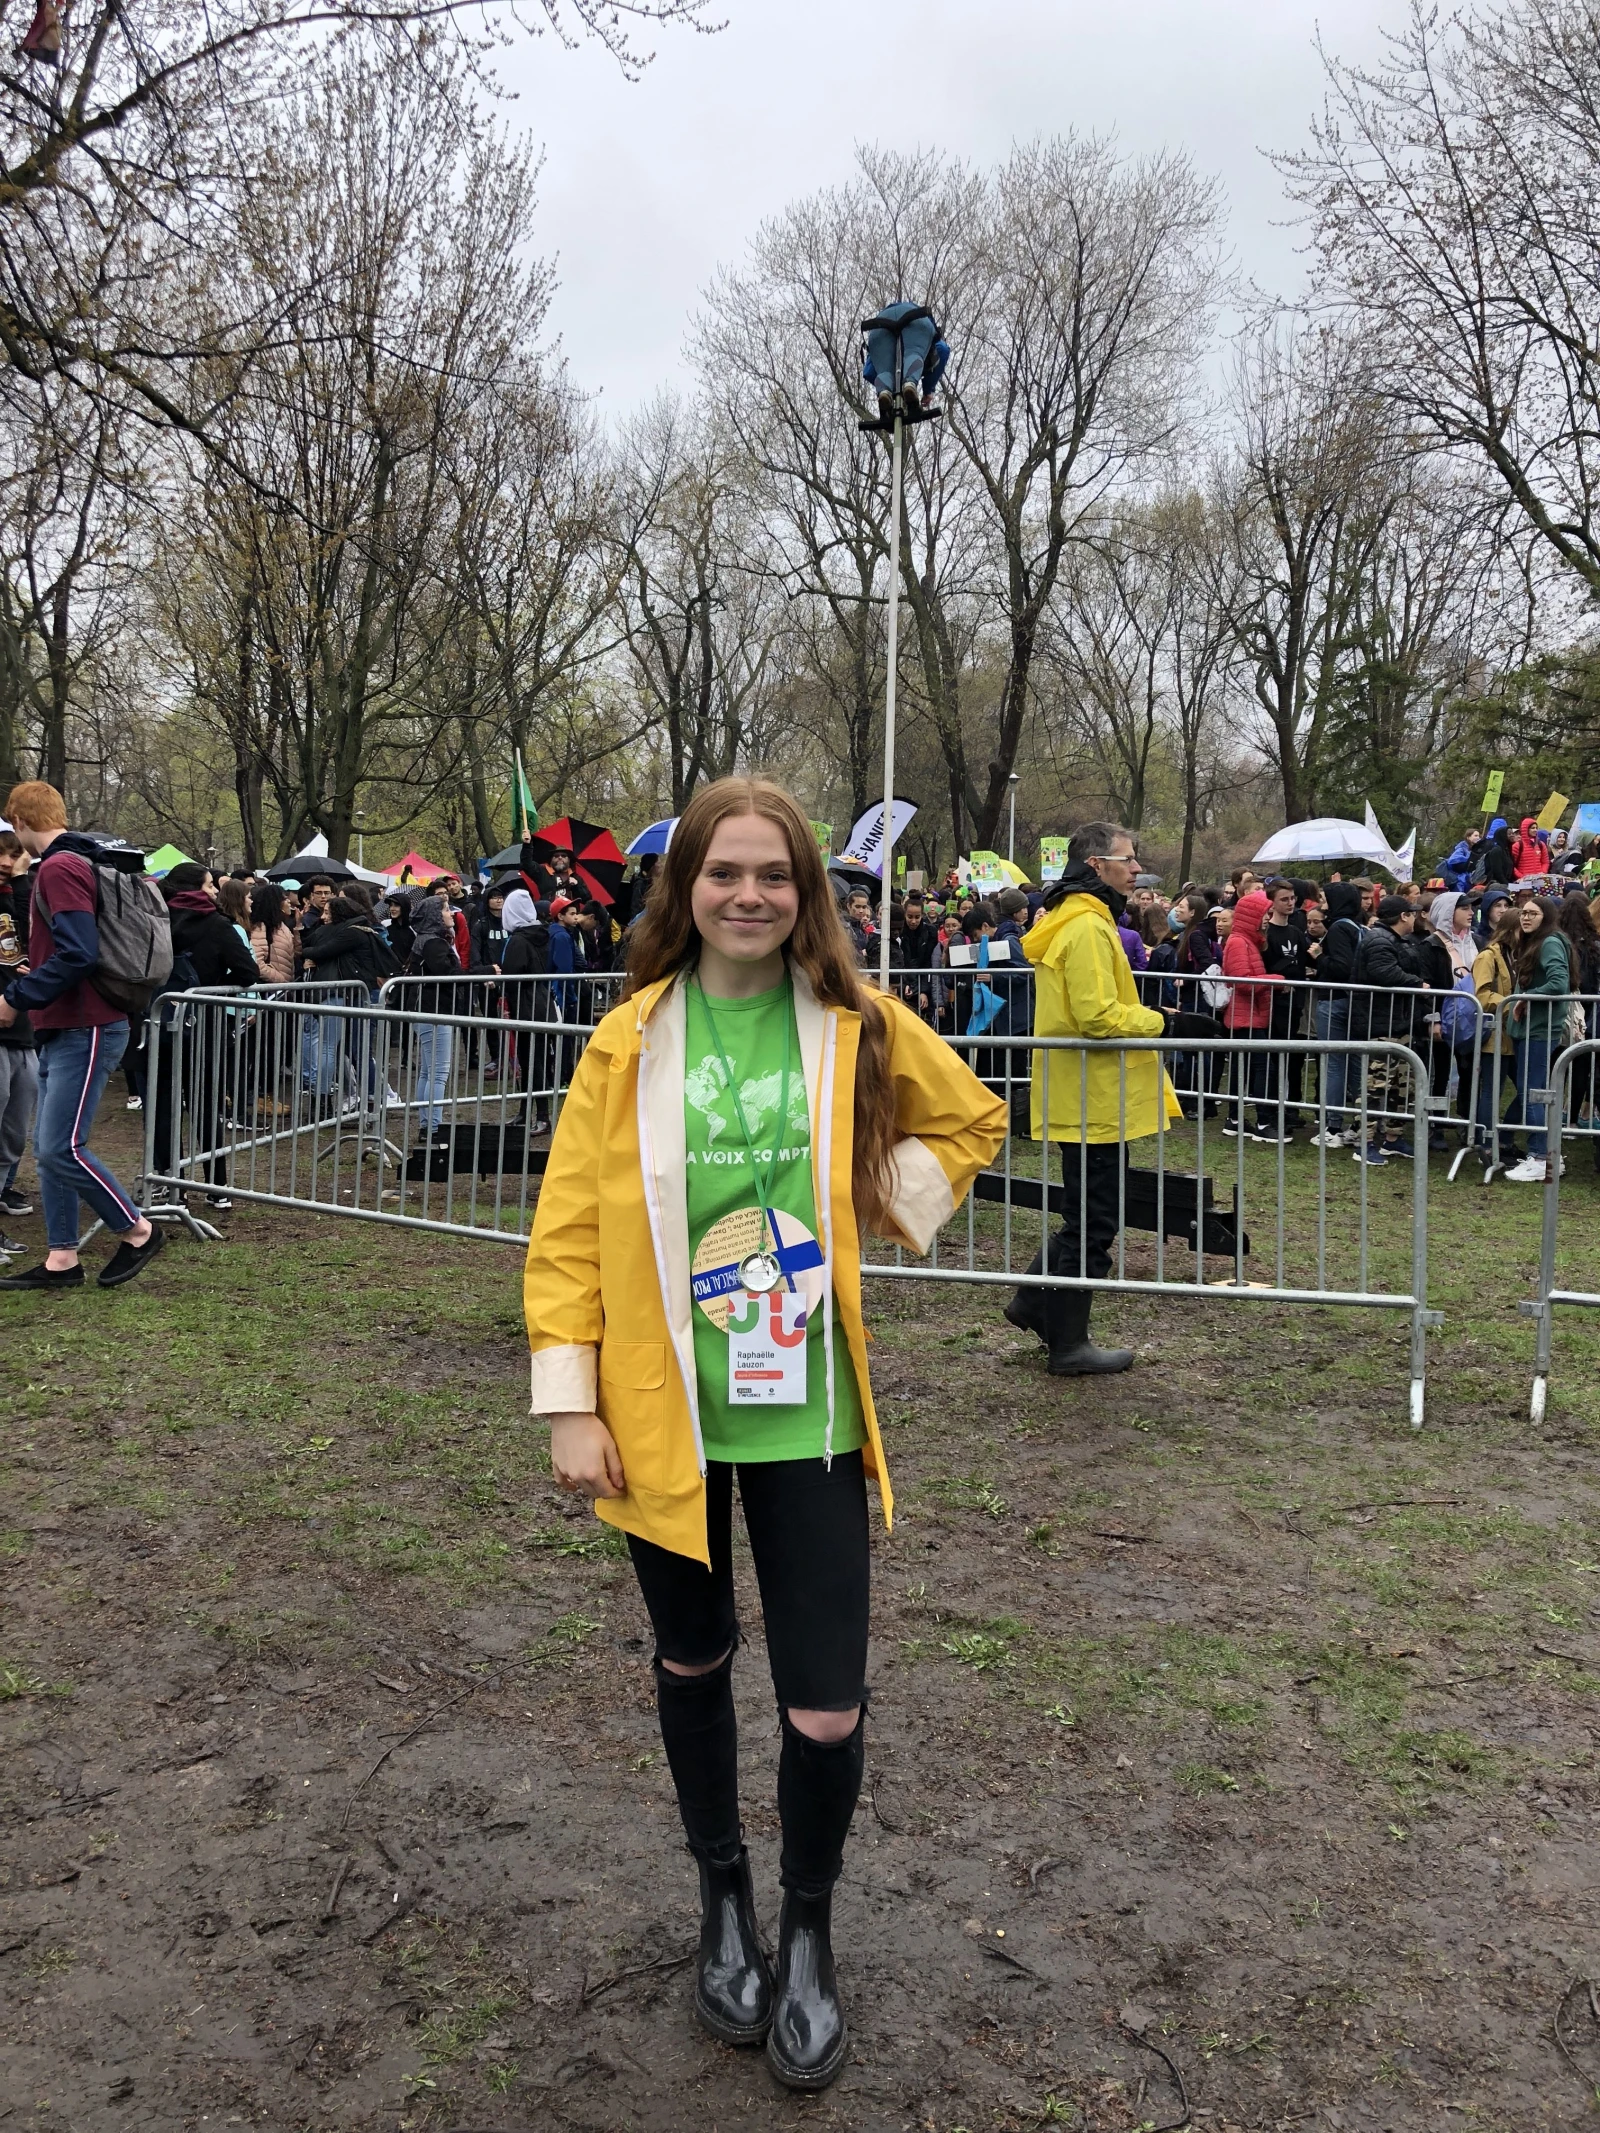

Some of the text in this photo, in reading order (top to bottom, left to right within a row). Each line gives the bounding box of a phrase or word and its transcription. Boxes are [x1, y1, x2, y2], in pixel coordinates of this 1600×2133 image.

[702, 1151, 745, 1164] VOIX
[751, 1146, 812, 1163] COMPT
[733, 1219, 756, 1229] Marche
[719, 1233, 740, 1243] human
[740, 1229, 755, 1237] from
[702, 1245, 727, 1255] humaine
[727, 1241, 744, 1249] traite
[732, 1247, 748, 1256] brain
[705, 1253, 731, 1264] storming
[710, 1267, 741, 1291] USICAL
[737, 1351, 775, 1360] Raphaëlle
